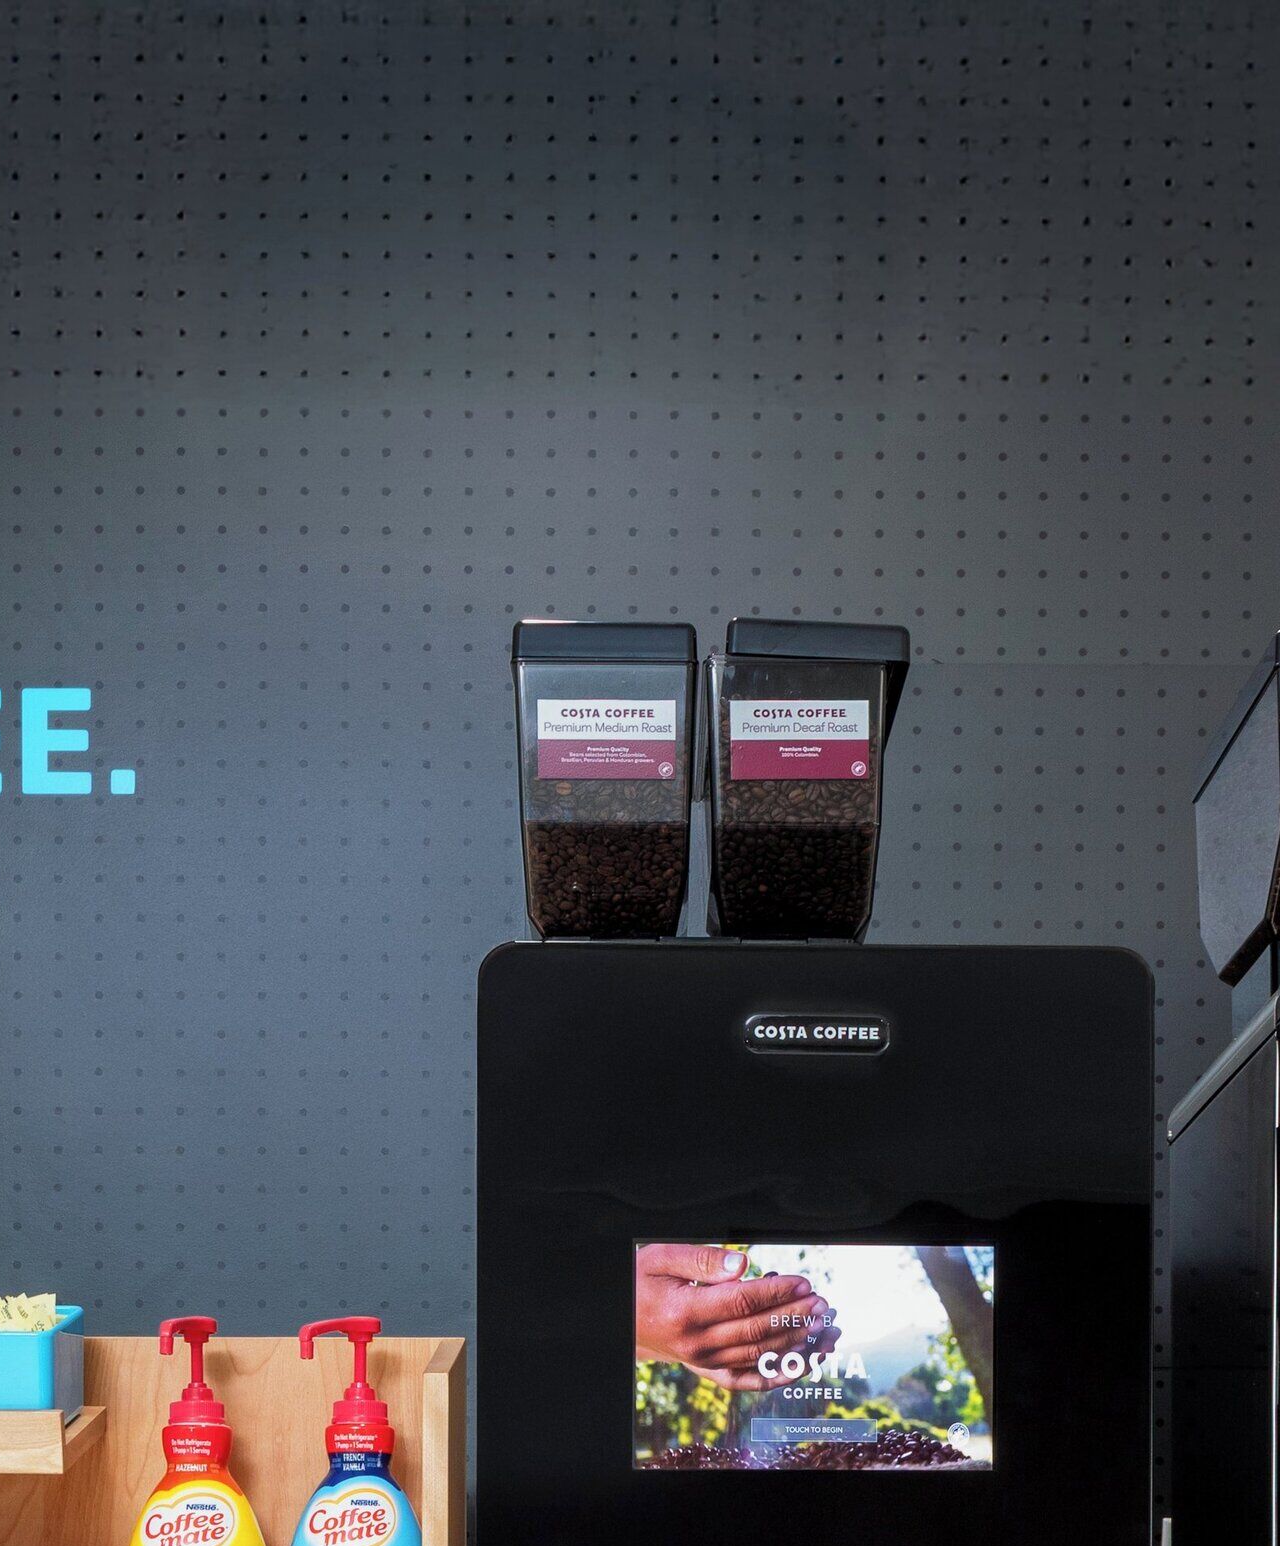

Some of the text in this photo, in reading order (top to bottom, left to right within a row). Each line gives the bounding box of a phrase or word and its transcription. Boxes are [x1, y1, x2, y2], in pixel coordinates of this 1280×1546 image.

[560, 708, 655, 719] COSTA COFFEE
[753, 708, 847, 719] COSTA COFFEE
[543, 721, 672, 733] Premium Medium Roast
[742, 722, 858, 733] Premium Decaf Roast
[754, 1025, 881, 1040] COSTA COFFEE
[770, 1315, 816, 1327] BREW
[807, 1334, 817, 1344] by
[757, 1351, 868, 1384] COSTA
[782, 1387, 843, 1399] COFFEE
[785, 1426, 810, 1434] TOUCH
[822, 1426, 844, 1434] BEGIN
[342, 1453, 365, 1462] FRENCH
[175, 1463, 208, 1472] HAZELNUT
[145, 1512, 225, 1539] Coffee
[309, 1507, 386, 1535] Coffee
[323, 1521, 388, 1546] mate
